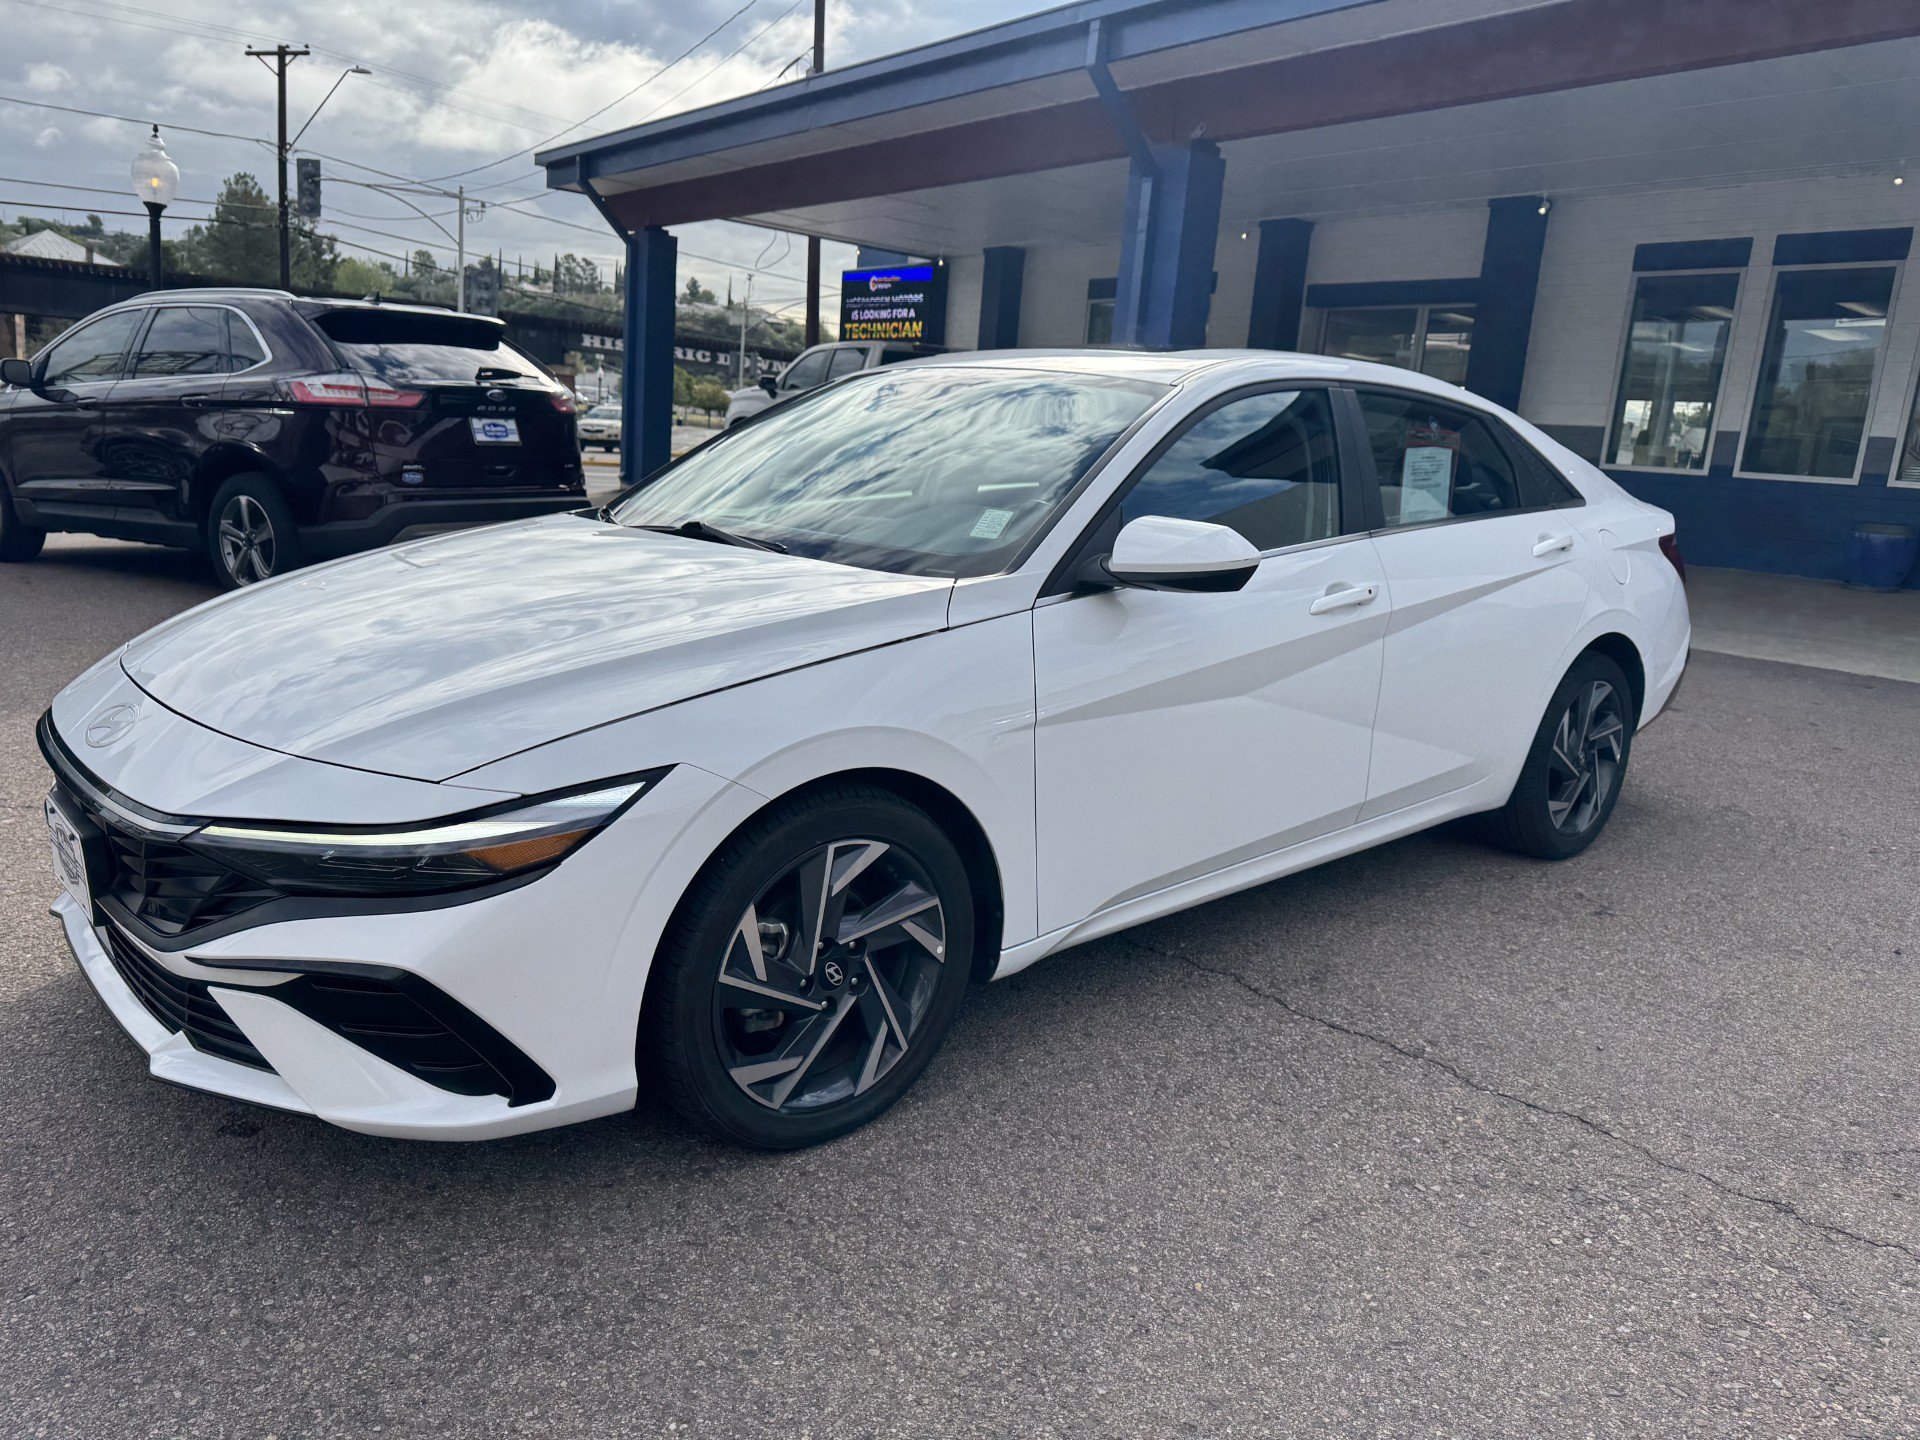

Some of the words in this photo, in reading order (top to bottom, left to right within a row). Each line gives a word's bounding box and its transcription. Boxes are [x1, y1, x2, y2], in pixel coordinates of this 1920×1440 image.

[851, 310, 859, 320] IS
[860, 309, 891, 320] LOOKING
[892, 308, 908, 319] FOR
[908, 308, 916, 318] A
[844, 321, 923, 339] TECHNICIAN
[581, 333, 711, 363] HISRIC
